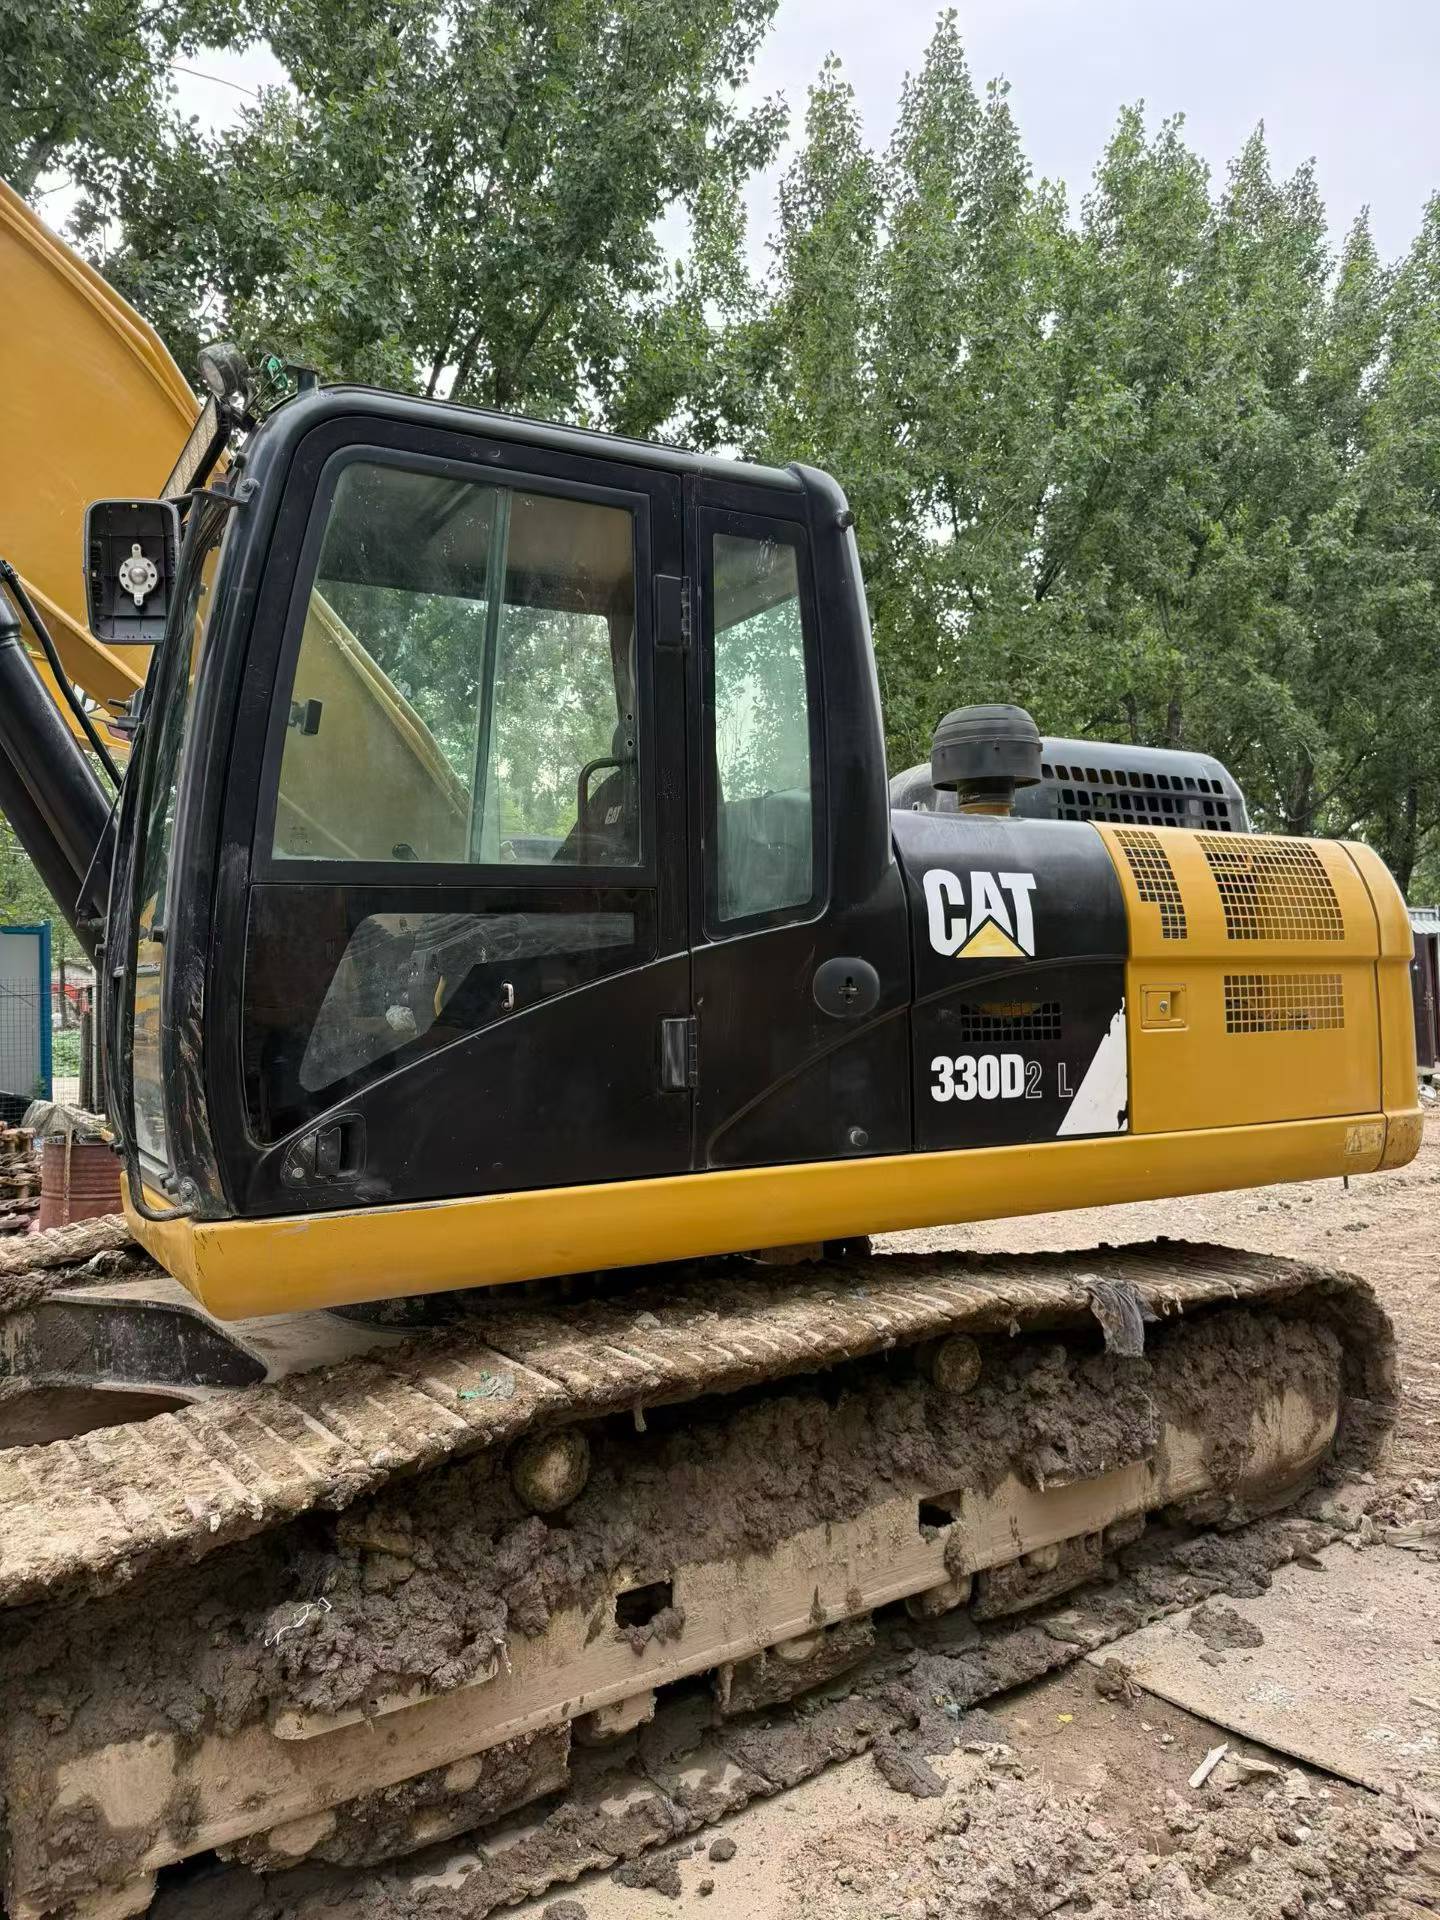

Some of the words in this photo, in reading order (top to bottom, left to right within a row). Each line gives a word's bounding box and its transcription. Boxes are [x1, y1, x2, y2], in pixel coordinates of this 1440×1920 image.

[923, 869, 1037, 957] CAT
[930, 1053, 1042, 1102] 330D2
[1058, 1062, 1074, 1098] L
